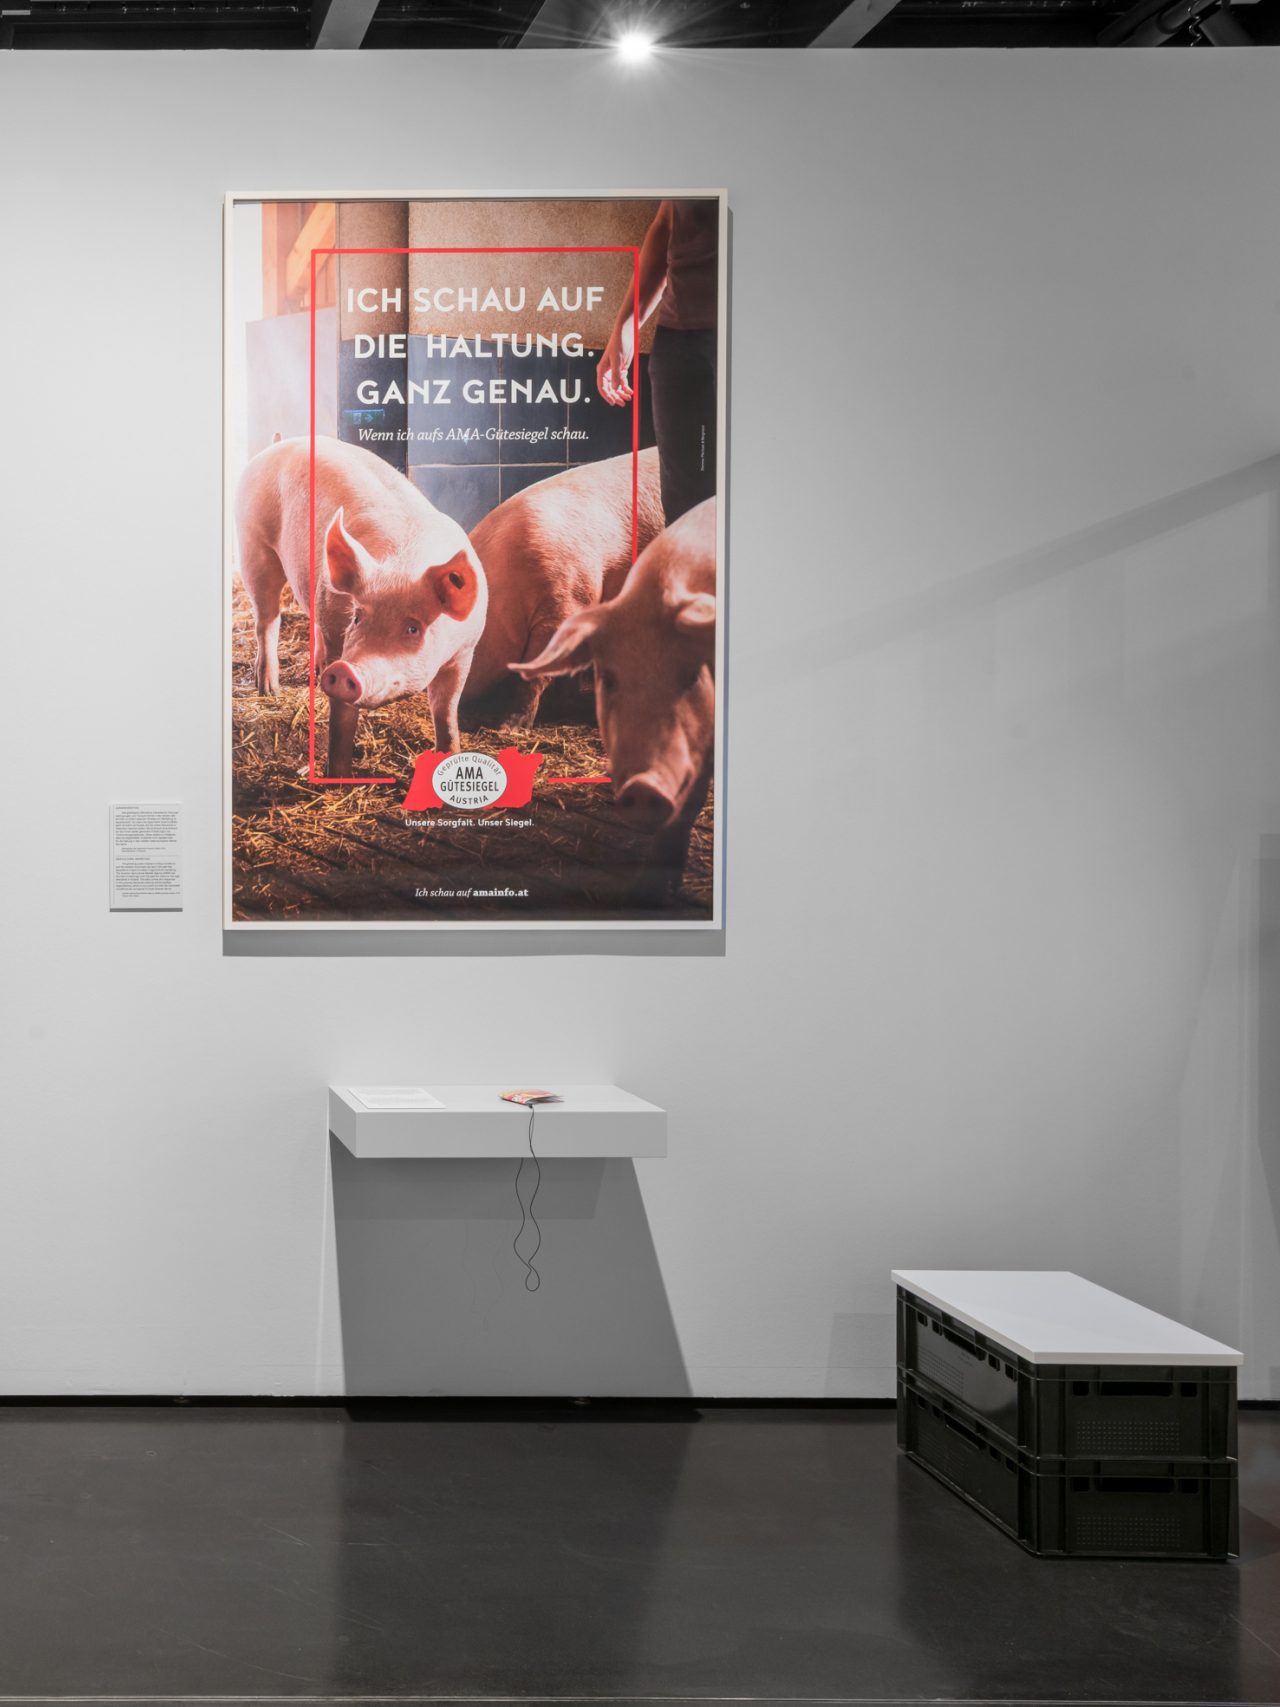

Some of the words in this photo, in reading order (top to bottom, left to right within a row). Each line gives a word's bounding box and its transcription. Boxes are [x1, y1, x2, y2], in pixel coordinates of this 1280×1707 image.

[347, 287, 401, 312] ICH
[414, 287, 526, 312] SCHAU
[537, 286, 604, 311] AUF
[354, 334, 407, 358] DIE
[426, 333, 594, 358] HALTUNG.
[356, 380, 451, 405] GANZ
[462, 379, 591, 404] GENAU.
[358, 428, 394, 441] Wenn
[397, 428, 414, 441] ich
[417, 427, 444, 443] aufs
[445, 427, 549, 444] AMA-Gütesiegel
[551, 427, 590, 440] schau.
[437, 756, 470, 776] Geprüfte
[455, 766, 484, 780] AMA
[440, 780, 499, 792] GÜTESIEGEL
[449, 794, 489, 805] AUSTRIA
[405, 818, 435, 827] Unsere
[437, 818, 476, 828] Sorgfalt.
[478, 818, 503, 827] Unser
[506, 818, 535, 828] Siegel.
[415, 887, 428, 897] Ich
[430, 887, 455, 897] schau
[456, 887, 473, 898] auf
[473, 887, 529, 897] amainfo.at
